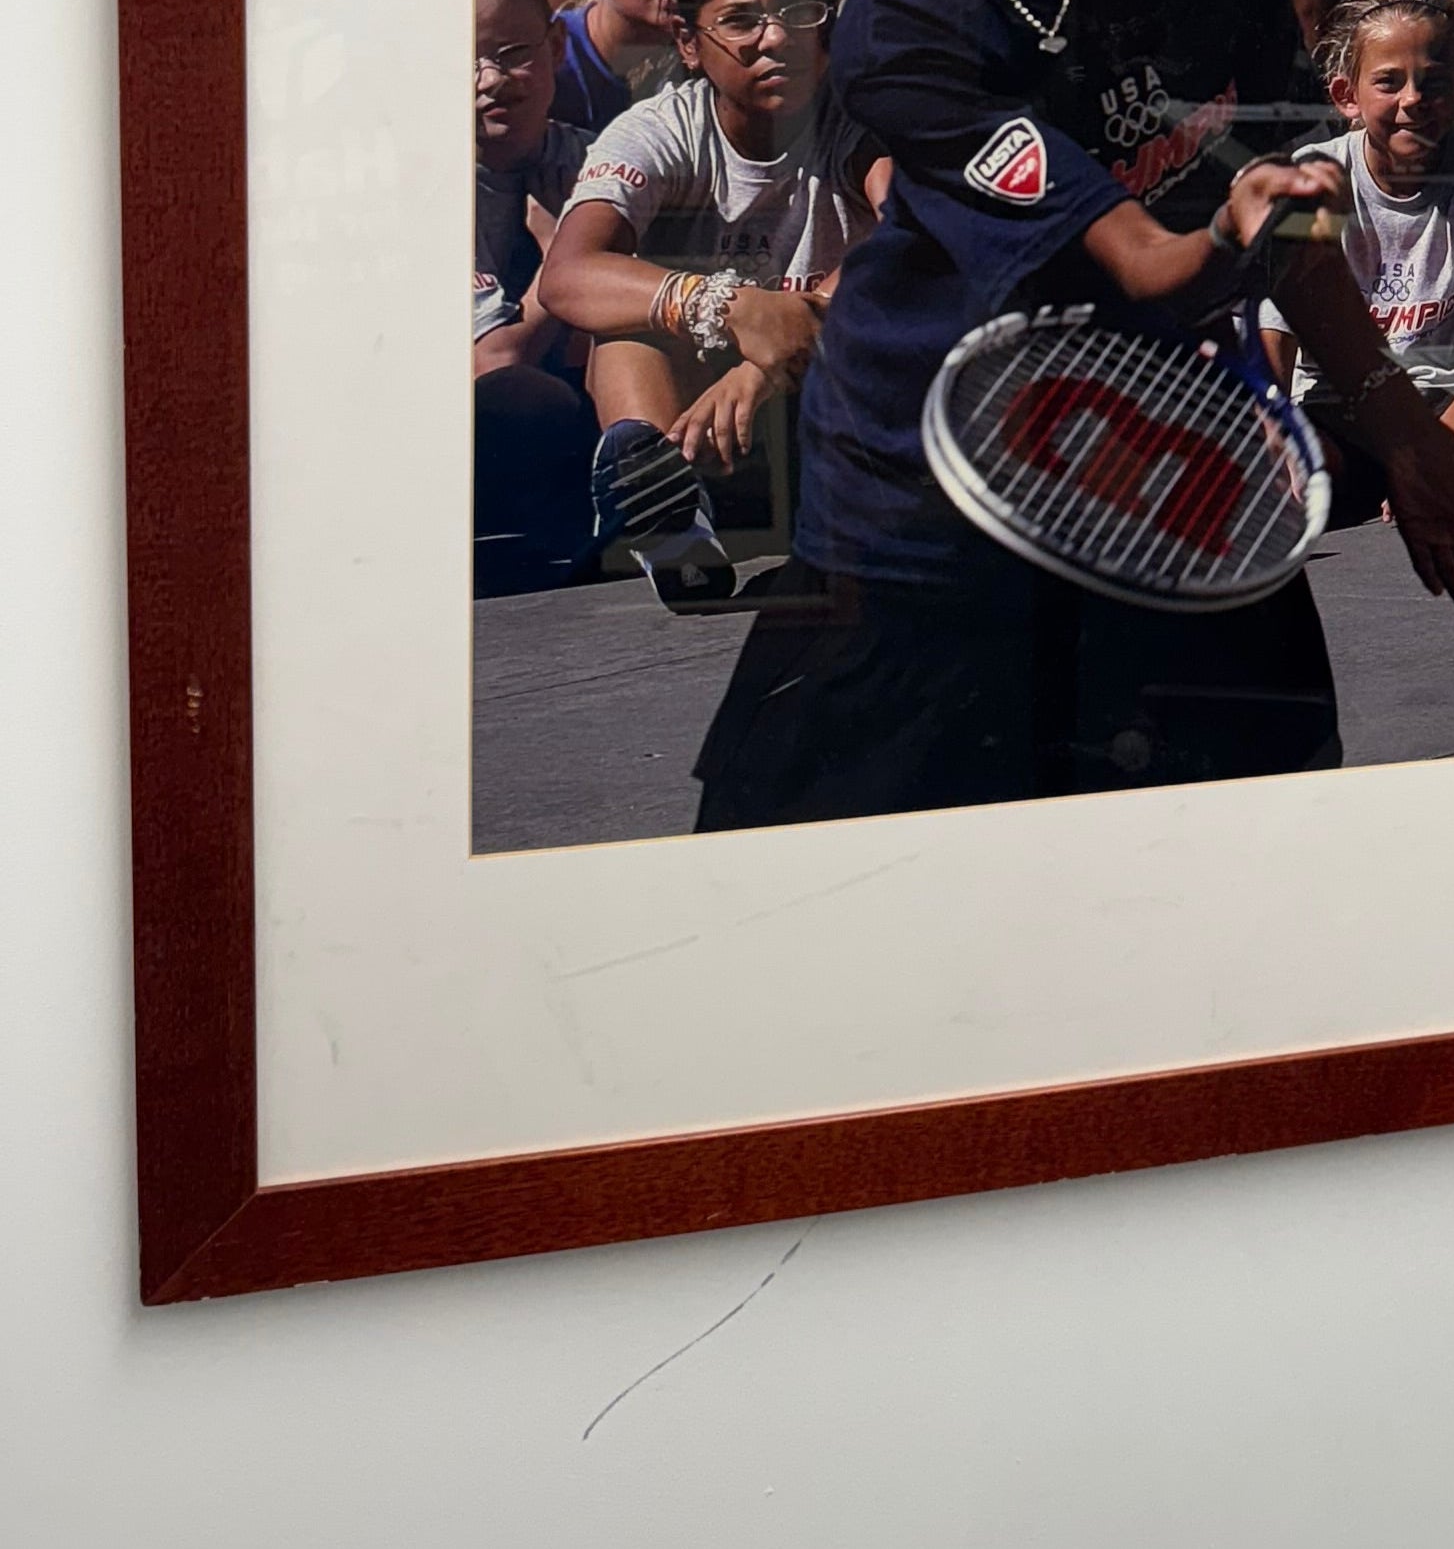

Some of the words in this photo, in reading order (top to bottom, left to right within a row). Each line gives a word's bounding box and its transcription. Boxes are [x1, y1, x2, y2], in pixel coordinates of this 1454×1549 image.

[1101, 65, 1162, 115] USA
[980, 129, 1032, 177] USTA
[578, 163, 646, 189] ND-AID
[721, 234, 770, 250] USA
[1376, 263, 1414, 278] USA
